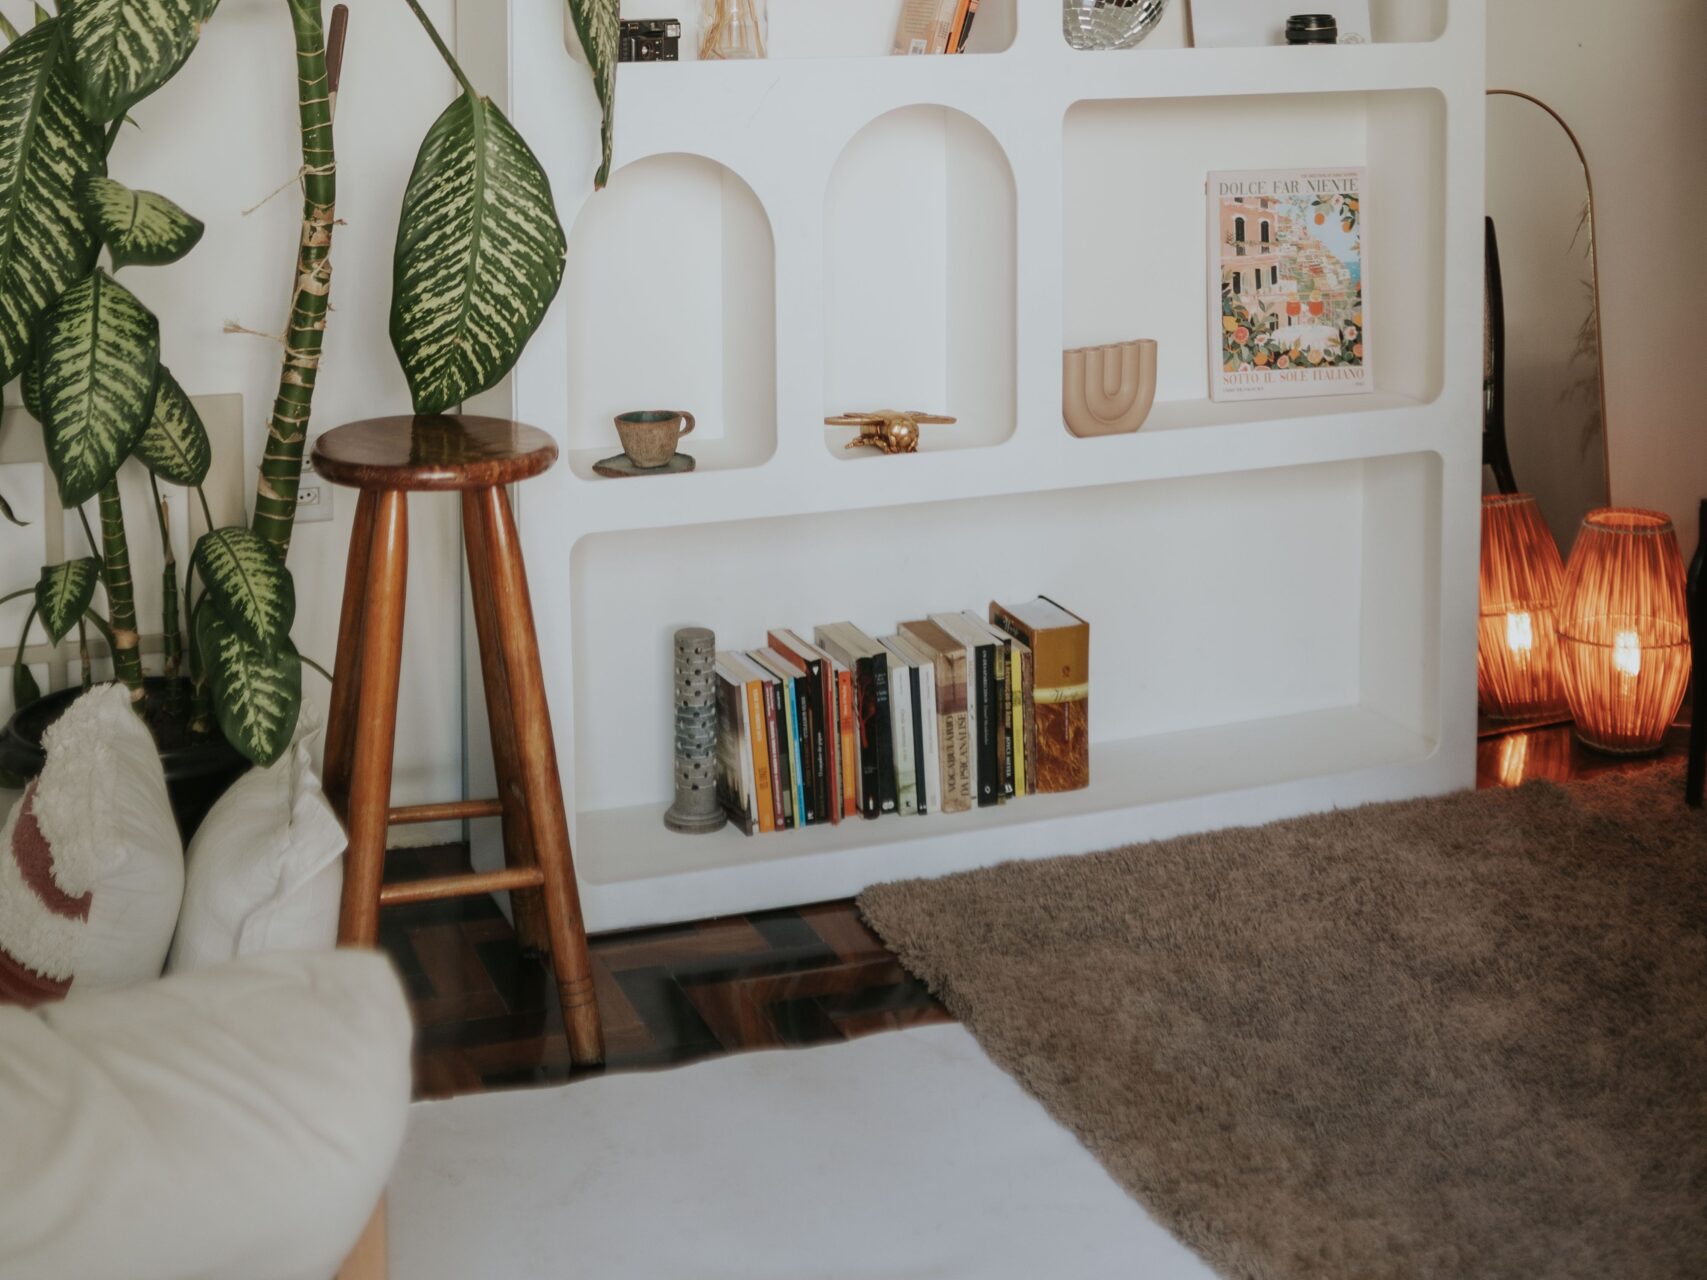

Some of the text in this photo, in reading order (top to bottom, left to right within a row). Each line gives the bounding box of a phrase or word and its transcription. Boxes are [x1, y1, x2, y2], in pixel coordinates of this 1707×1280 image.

[1219, 178, 1359, 195] DOLCE FAR NIENTE
[1223, 367, 1364, 384] SOTTO IL SOLE ITALIANO
[960, 782, 969, 796] DA
